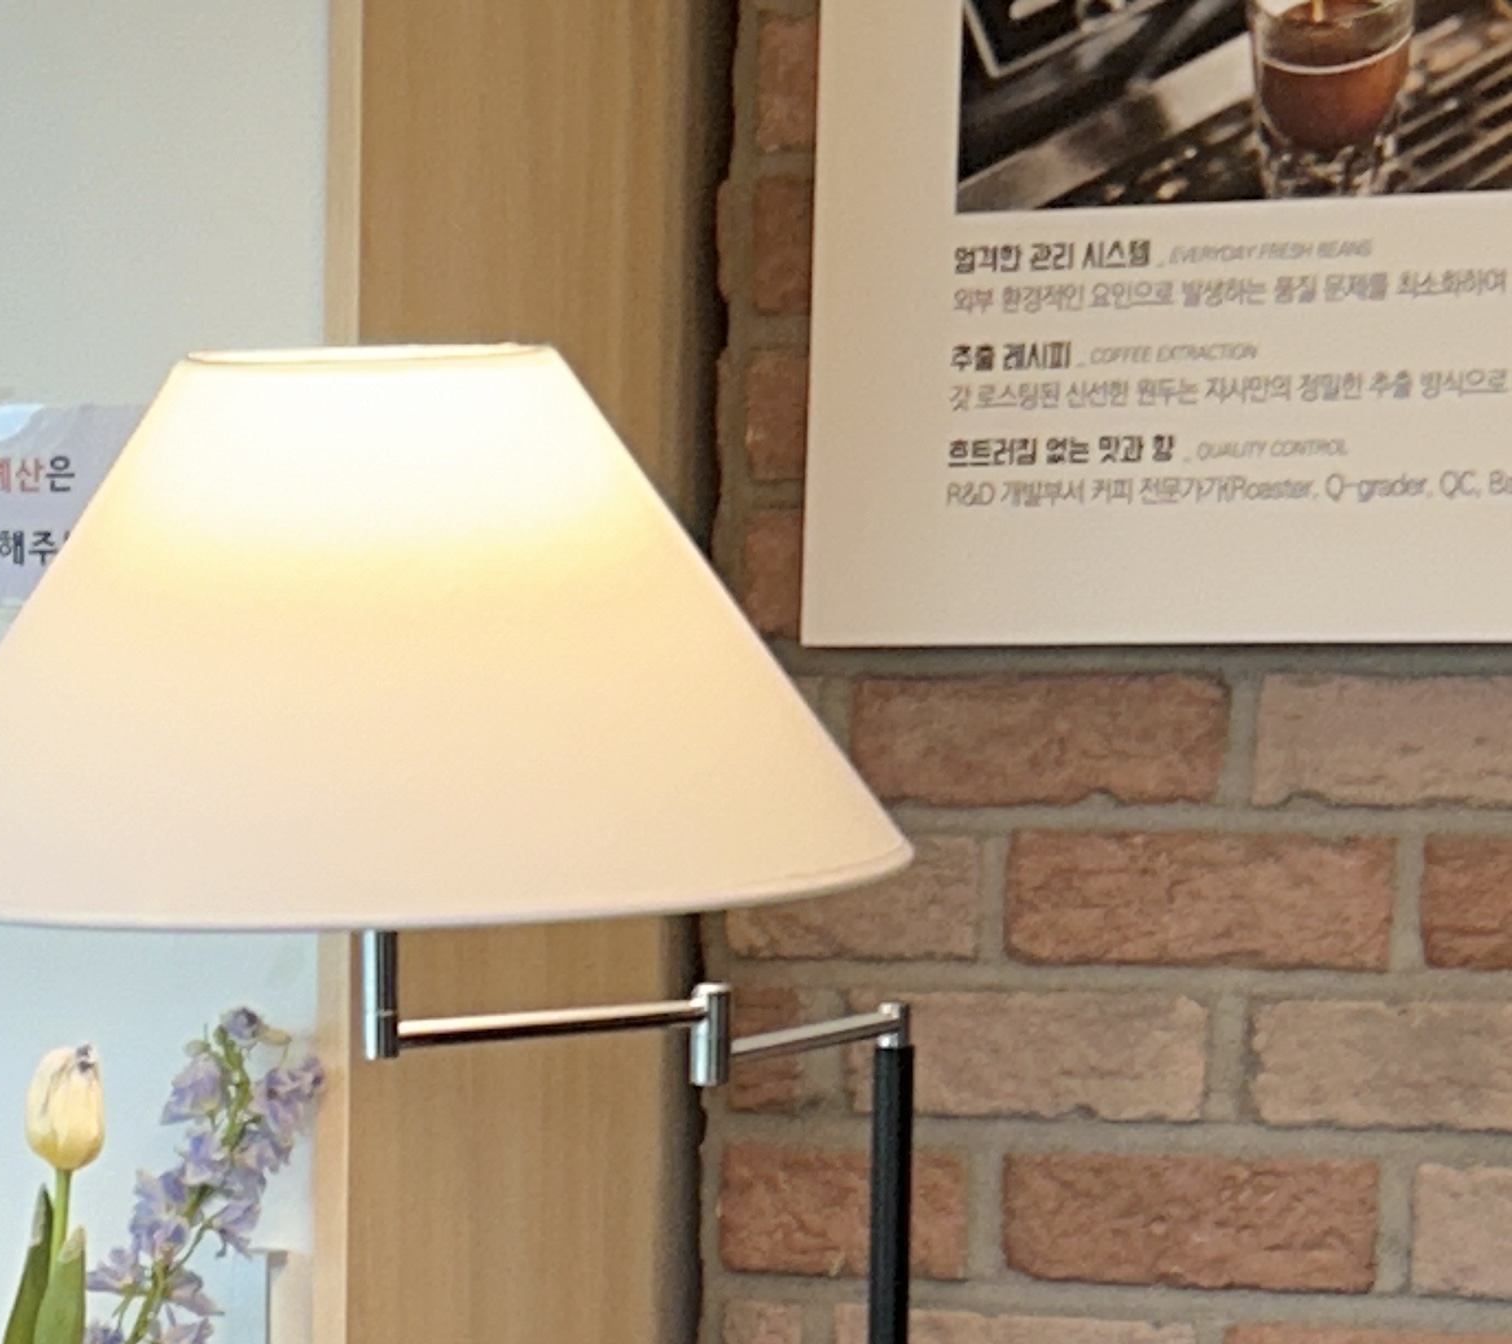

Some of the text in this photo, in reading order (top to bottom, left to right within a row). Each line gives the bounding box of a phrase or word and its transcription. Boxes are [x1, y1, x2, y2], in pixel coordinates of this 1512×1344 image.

[954, 243, 1022, 274] 엄격한
[1030, 242, 1075, 271] 관리
[1081, 239, 1150, 269] 시스템
[952, 287, 993, 315] 외부
[1089, 280, 1174, 309] 요인으로
[1181, 277, 1267, 307] 발생하는
[1324, 272, 1389, 301] 문제를
[1396, 268, 1506, 297] 최소화하여
[951, 345, 995, 371] 추출
[1003, 341, 1071, 370] 레시피
[1090, 346, 1151, 364] COFFEE
[949, 384, 972, 412] 갓
[974, 381, 1060, 410] 로스팅된
[1065, 380, 1129, 409] 신선한
[1137, 378, 1197, 407] 원두는
[1204, 374, 1292, 404] 자사만의
[1420, 367, 1509, 398] 방식으로
[948, 433, 1348, 467] 흐트러짐 없는 맛과 향 QUALITY CONTROL
[1000, 478, 1085, 507] 개발부서
[1092, 477, 1133, 505] 커피
